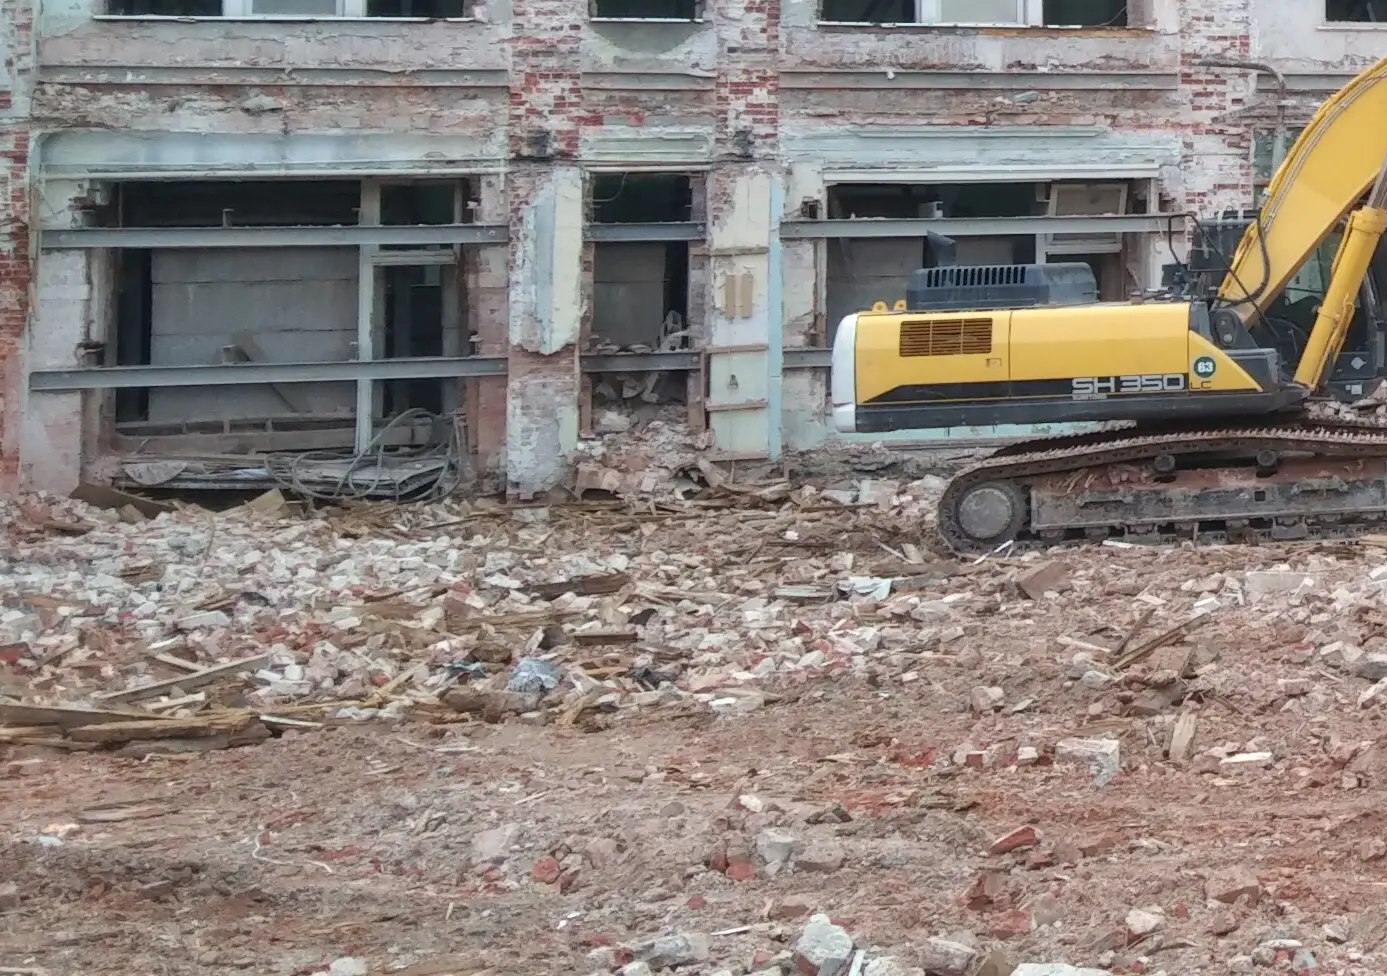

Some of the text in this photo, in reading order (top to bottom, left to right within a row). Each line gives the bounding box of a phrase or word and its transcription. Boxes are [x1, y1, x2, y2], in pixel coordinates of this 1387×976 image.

[1197, 362, 1213, 373] 63
[1072, 374, 1184, 393] SH 350
[1191, 381, 1212, 390] LC
